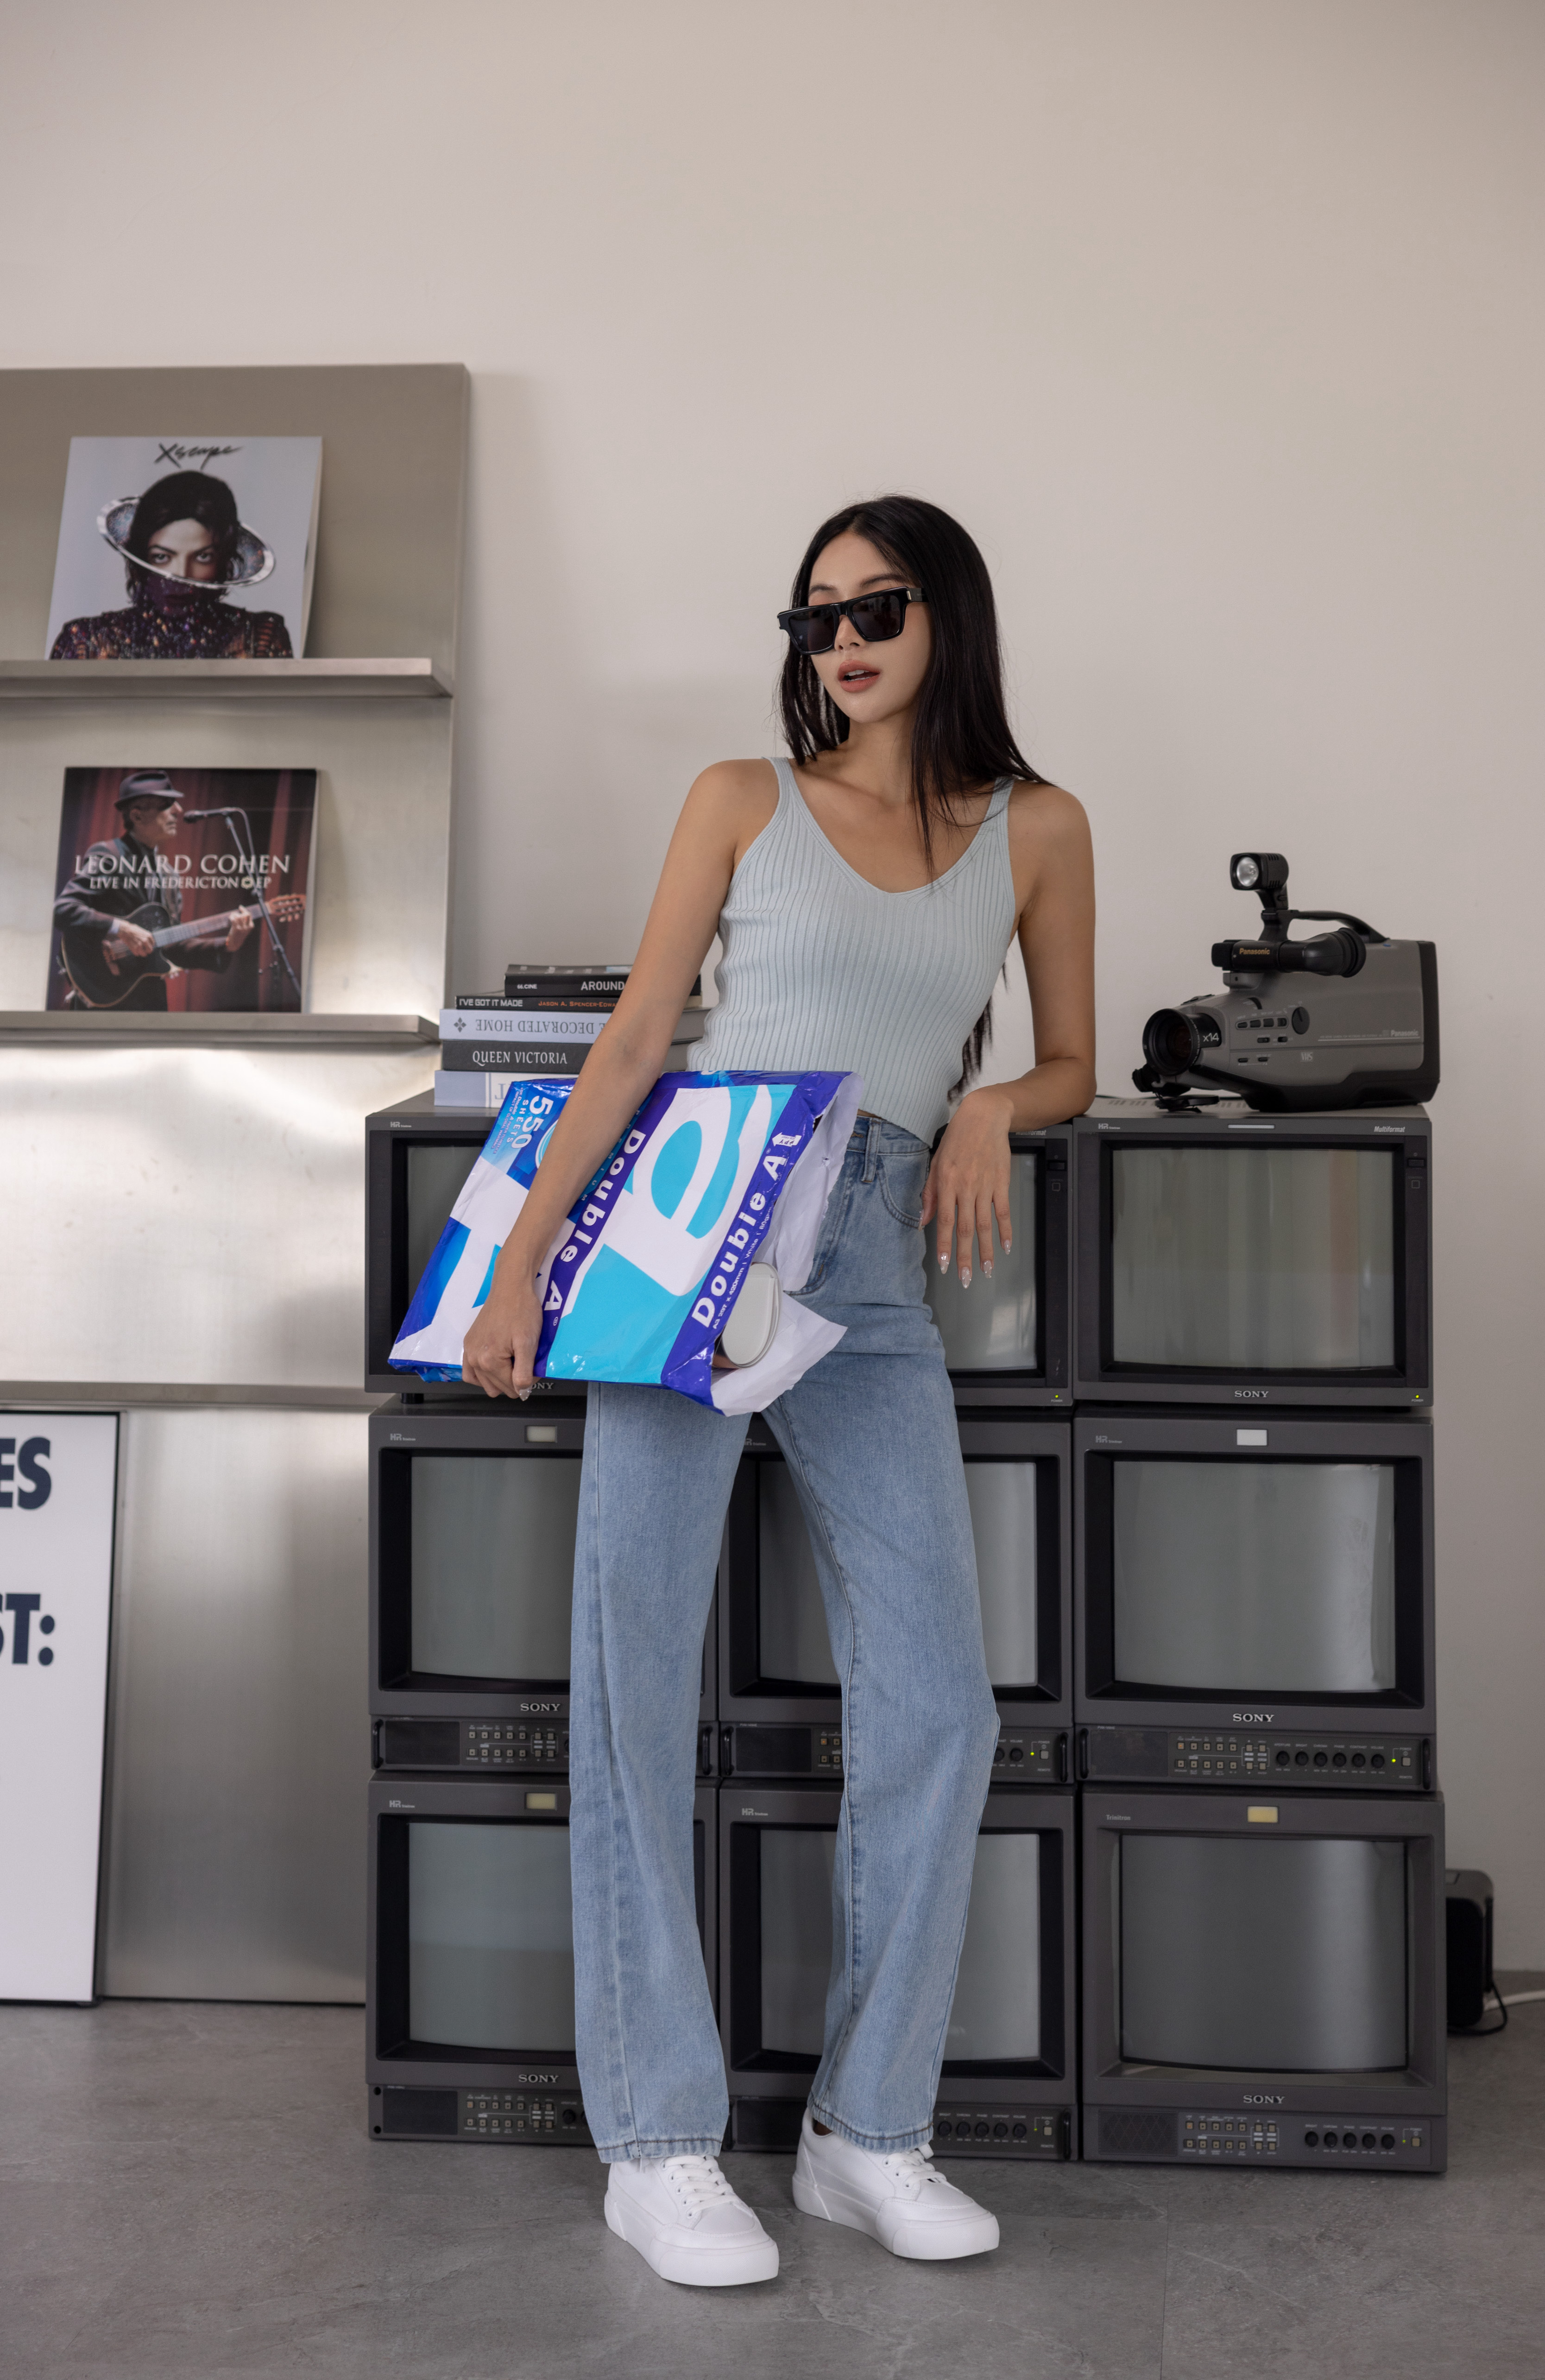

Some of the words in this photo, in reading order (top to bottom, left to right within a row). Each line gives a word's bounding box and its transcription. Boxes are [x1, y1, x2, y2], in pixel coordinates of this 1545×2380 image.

[154, 443, 243, 470] Xscape
[75, 855, 192, 875] LEONARD
[200, 854, 290, 874] COHEN
[89, 876, 119, 889] LIVE
[123, 877, 139, 889] IN
[144, 876, 240, 889] FREDERICTON
[256, 876, 272, 889] EP
[581, 981, 625, 991] AROUND
[476, 1020, 513, 1032] HOME
[518, 1020, 594, 1034] DECORATED
[1203, 1033, 1219, 1042] x14
[472, 1051, 511, 1066] QUEEN
[515, 1051, 568, 1064] VICTORIA
[1301, 1052, 1313, 1062] VHS
[507, 1099, 529, 1143] SHEETS
[511, 1096, 554, 1148] 550
[560, 1129, 646, 1262] Double
[692, 1192, 765, 1328] Double
[763, 1156, 787, 1181] A
[713, 1319, 719, 1329] A3
[718, 1303, 728, 1317] 297
[729, 1268, 744, 1295] 420mm
[745, 1238, 759, 1259] White
[544, 1280, 563, 1311] A
[0, 1593, 55, 1667] T:
[520, 1703, 561, 1712] SONY
[1232, 1713, 1275, 1722] SONY
[518, 2074, 559, 2083] SONY
[1243, 2095, 1286, 2104] SONY
